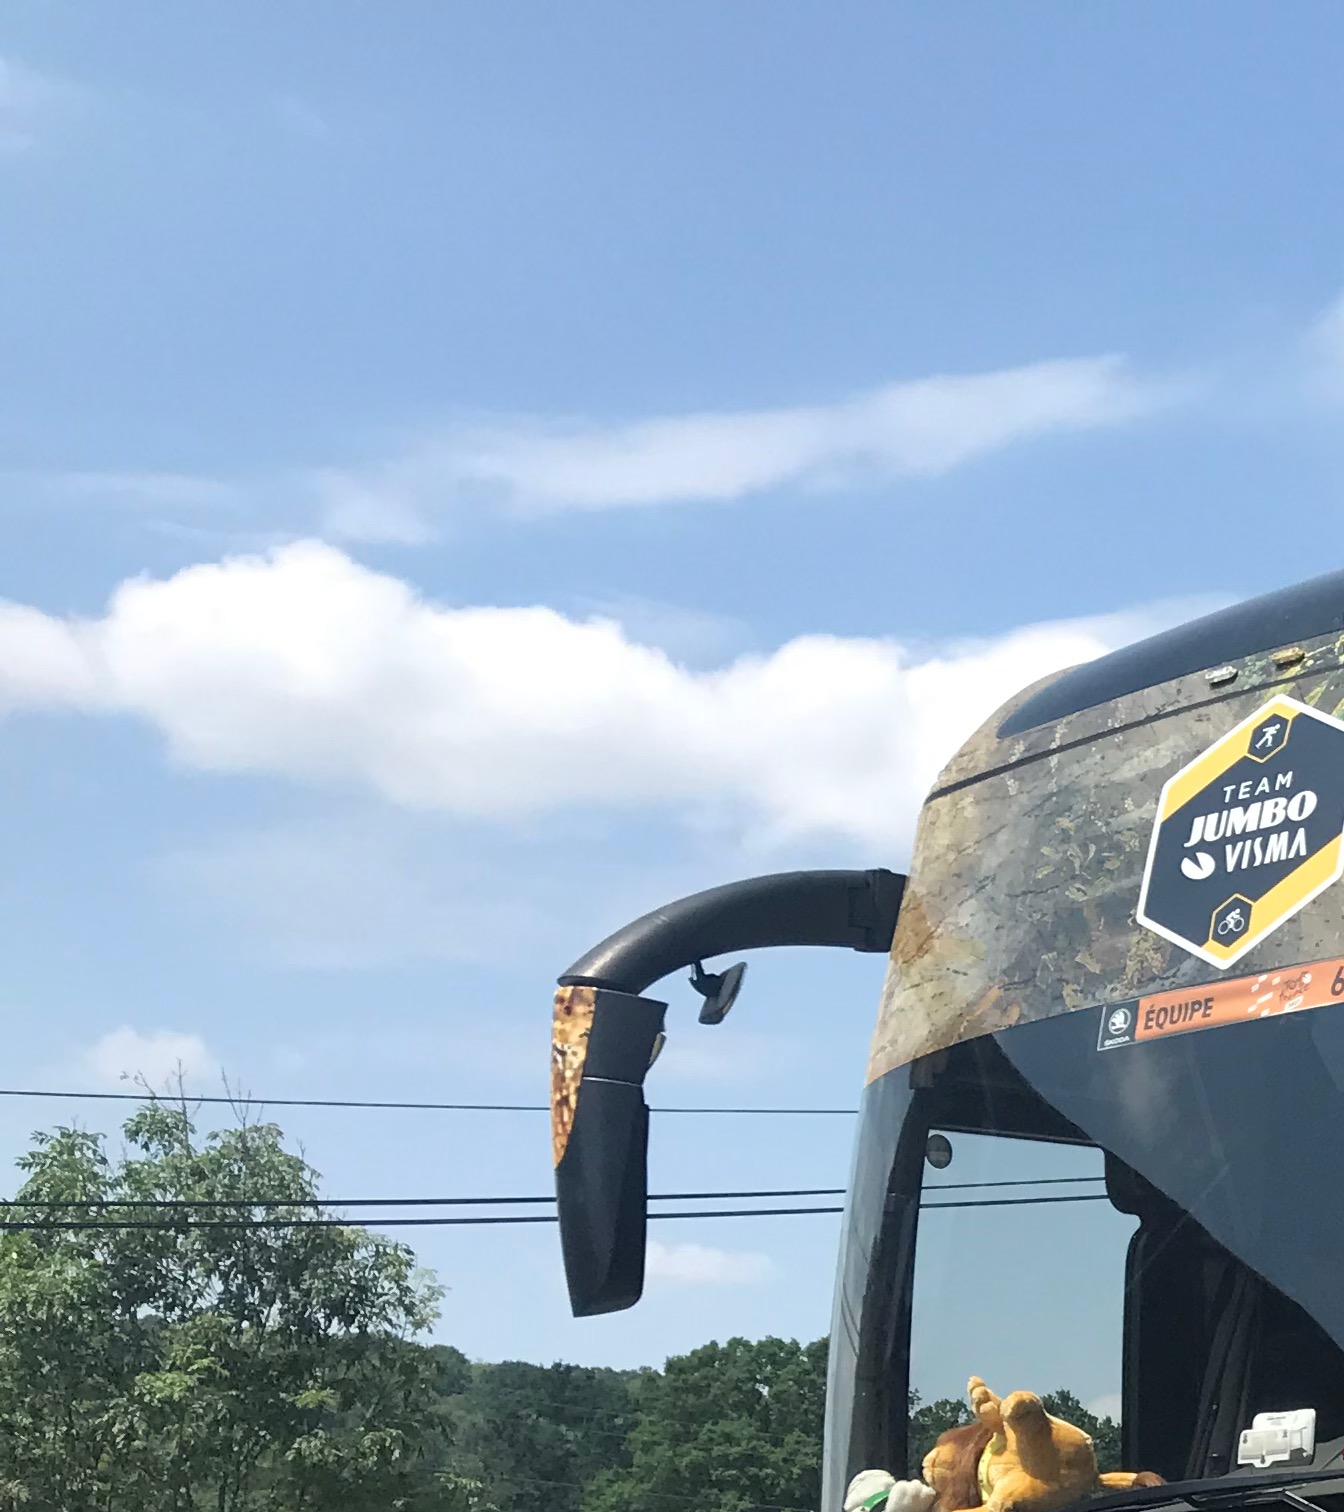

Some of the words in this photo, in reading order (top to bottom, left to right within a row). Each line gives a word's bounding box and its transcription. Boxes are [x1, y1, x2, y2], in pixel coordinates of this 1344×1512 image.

[1222, 770, 1294, 804] TEAM
[1183, 790, 1318, 848] JUMBO
[1225, 828, 1308, 873] VISMA
[1143, 997, 1215, 1031] ÉQUIPE
